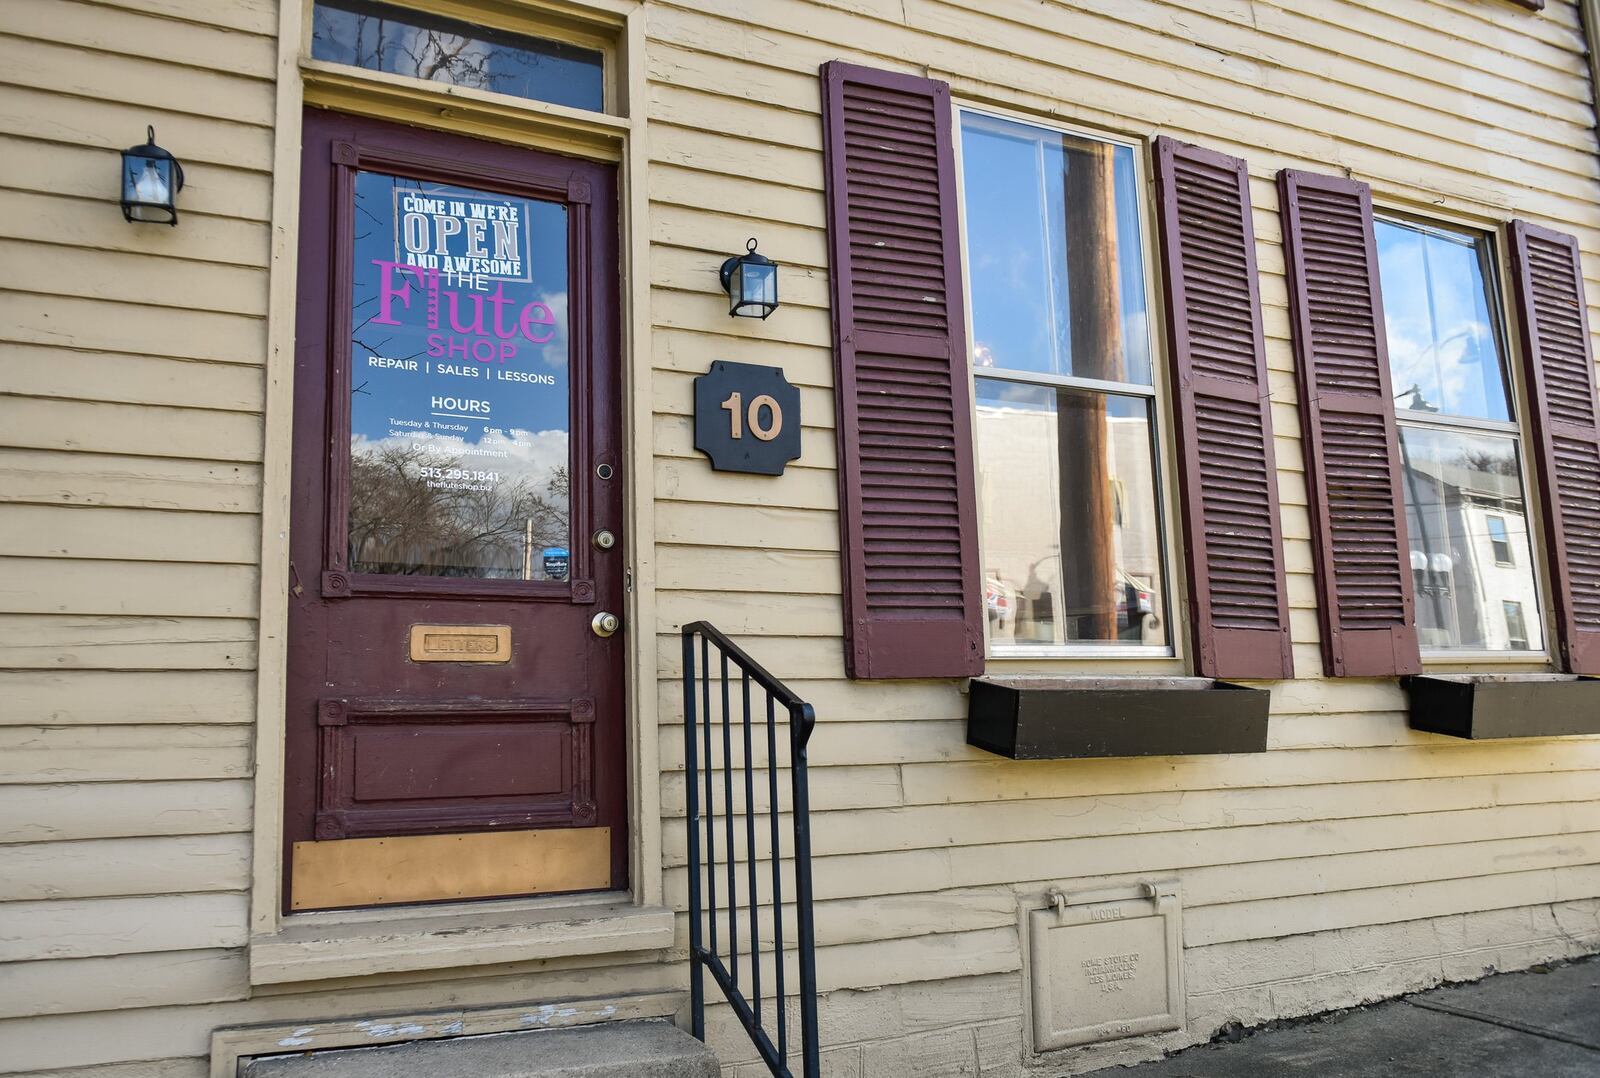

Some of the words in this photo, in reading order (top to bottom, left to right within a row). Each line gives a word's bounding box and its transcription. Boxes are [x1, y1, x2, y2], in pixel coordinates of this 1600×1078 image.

[403, 195, 445, 213] COME
[450, 202, 465, 217] IN
[470, 203, 518, 221] WE'RE
[403, 212, 521, 261] OPEN
[407, 253, 438, 269] AND
[442, 256, 521, 276] AWESOME
[445, 271, 489, 291] THE
[369, 259, 556, 344] Flute
[427, 334, 518, 363] SHOP
[368, 356, 418, 371] REPAIR
[437, 364, 479, 377] SALES
[498, 370, 555, 385] LESSONS
[431, 396, 491, 413] HOURS
[389, 418, 423, 429] Tuesday
[432, 422, 469, 432] Thursday
[721, 391, 783, 441] 10
[435, 433, 464, 442] Sunday
[428, 444, 441, 454] By
[444, 446, 508, 459] Appointment
[420, 467, 499, 482] 513.295.1841
[1091, 907, 1125, 921] MODEL
